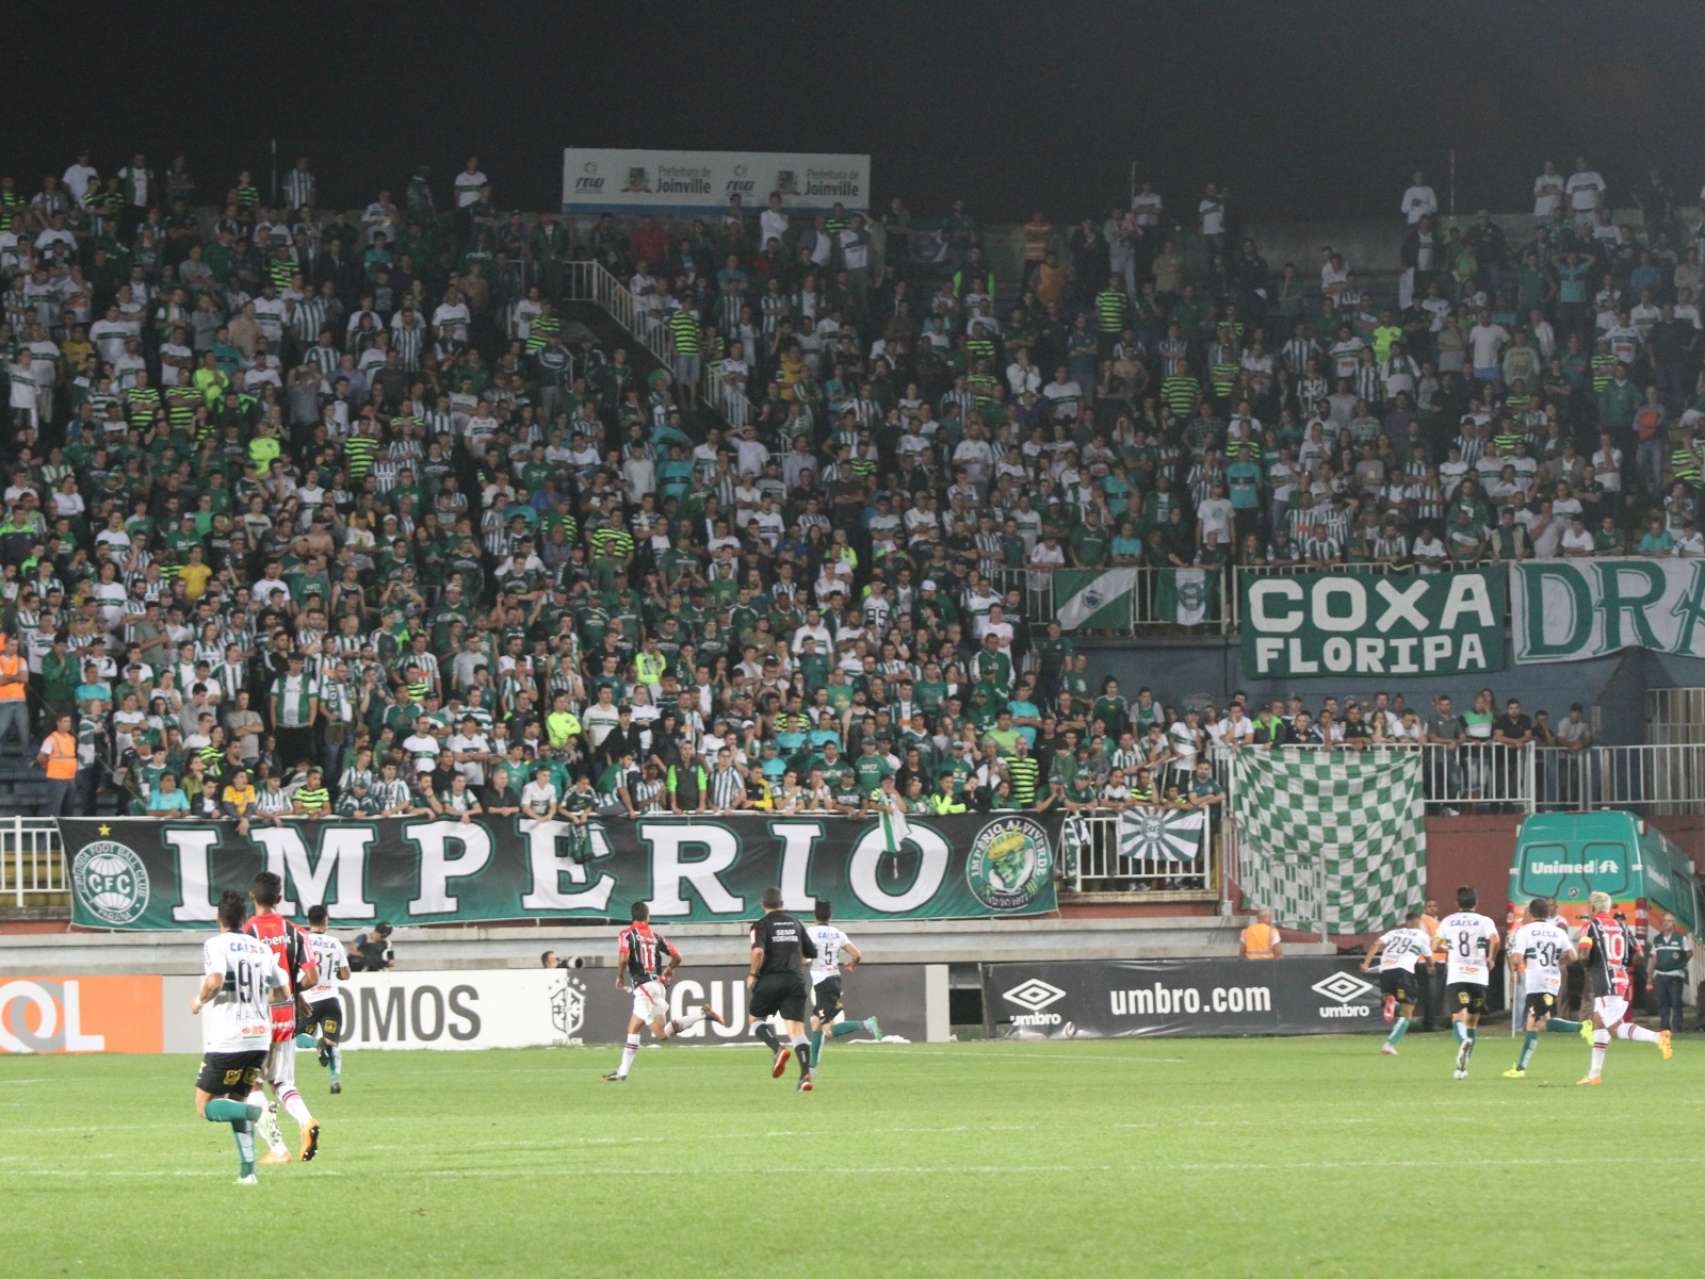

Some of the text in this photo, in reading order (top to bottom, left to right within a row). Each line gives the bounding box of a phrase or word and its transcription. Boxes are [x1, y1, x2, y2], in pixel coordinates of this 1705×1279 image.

[656, 178, 712, 193] Joinville
[806, 180, 859, 196] Joinville
[1249, 573, 1496, 633] COXA
[1256, 633, 1487, 673] FLORIPA
[165, 817, 950, 922] IMPERIO
[1531, 860, 1595, 875] Unimed
[88, 873, 132, 894] CFC
[641, 942, 656, 970] 11
[824, 943, 833, 966] 5
[1458, 931, 1470, 957] 8
[1603, 933, 1626, 961] 10
[238, 959, 264, 1003] 91
[1110, 982, 1272, 1016] umbro.com
[1319, 1004, 1370, 1019] umbro
[1010, 1011, 1061, 1027] umbro
